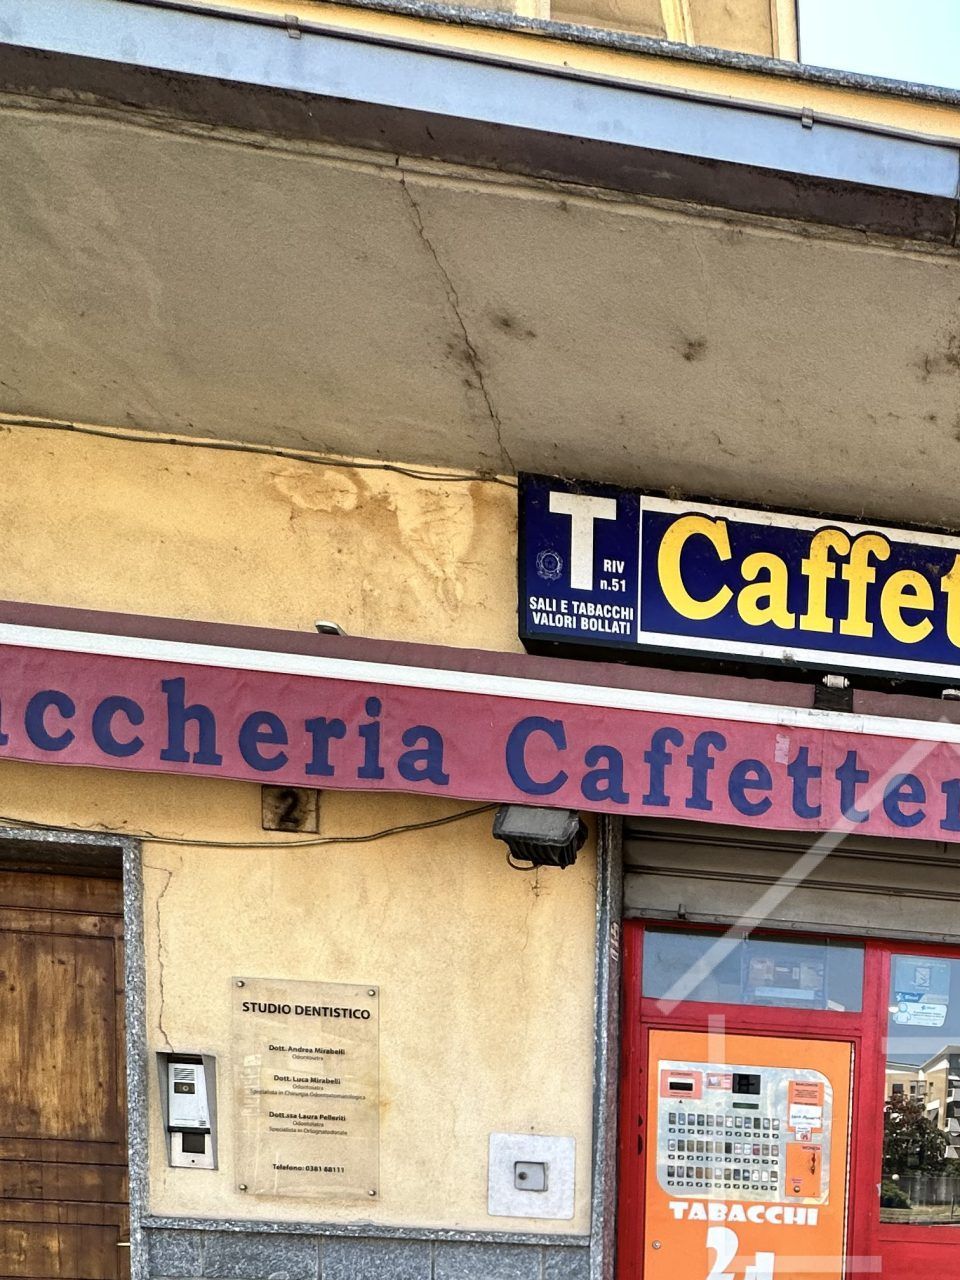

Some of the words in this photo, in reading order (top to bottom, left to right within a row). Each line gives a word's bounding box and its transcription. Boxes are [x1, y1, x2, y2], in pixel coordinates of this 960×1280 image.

[548, 490, 617, 591] T
[603, 559, 625, 574] RIV
[600, 578, 626, 592] n.51
[529, 596, 557, 612] SALI
[560, 599, 569, 613] E
[571, 601, 634, 621] TABACCHI
[532, 611, 577, 629] VALORI
[580, 616, 631, 635] BOLLATI
[0, 677, 450, 786] ccheria
[279, 789, 301, 824] 2
[242, 1001, 292, 1015] STUDIO
[294, 1005, 371, 1020] DENTISTICO
[668, 1201, 819, 1226] TABACCHI
